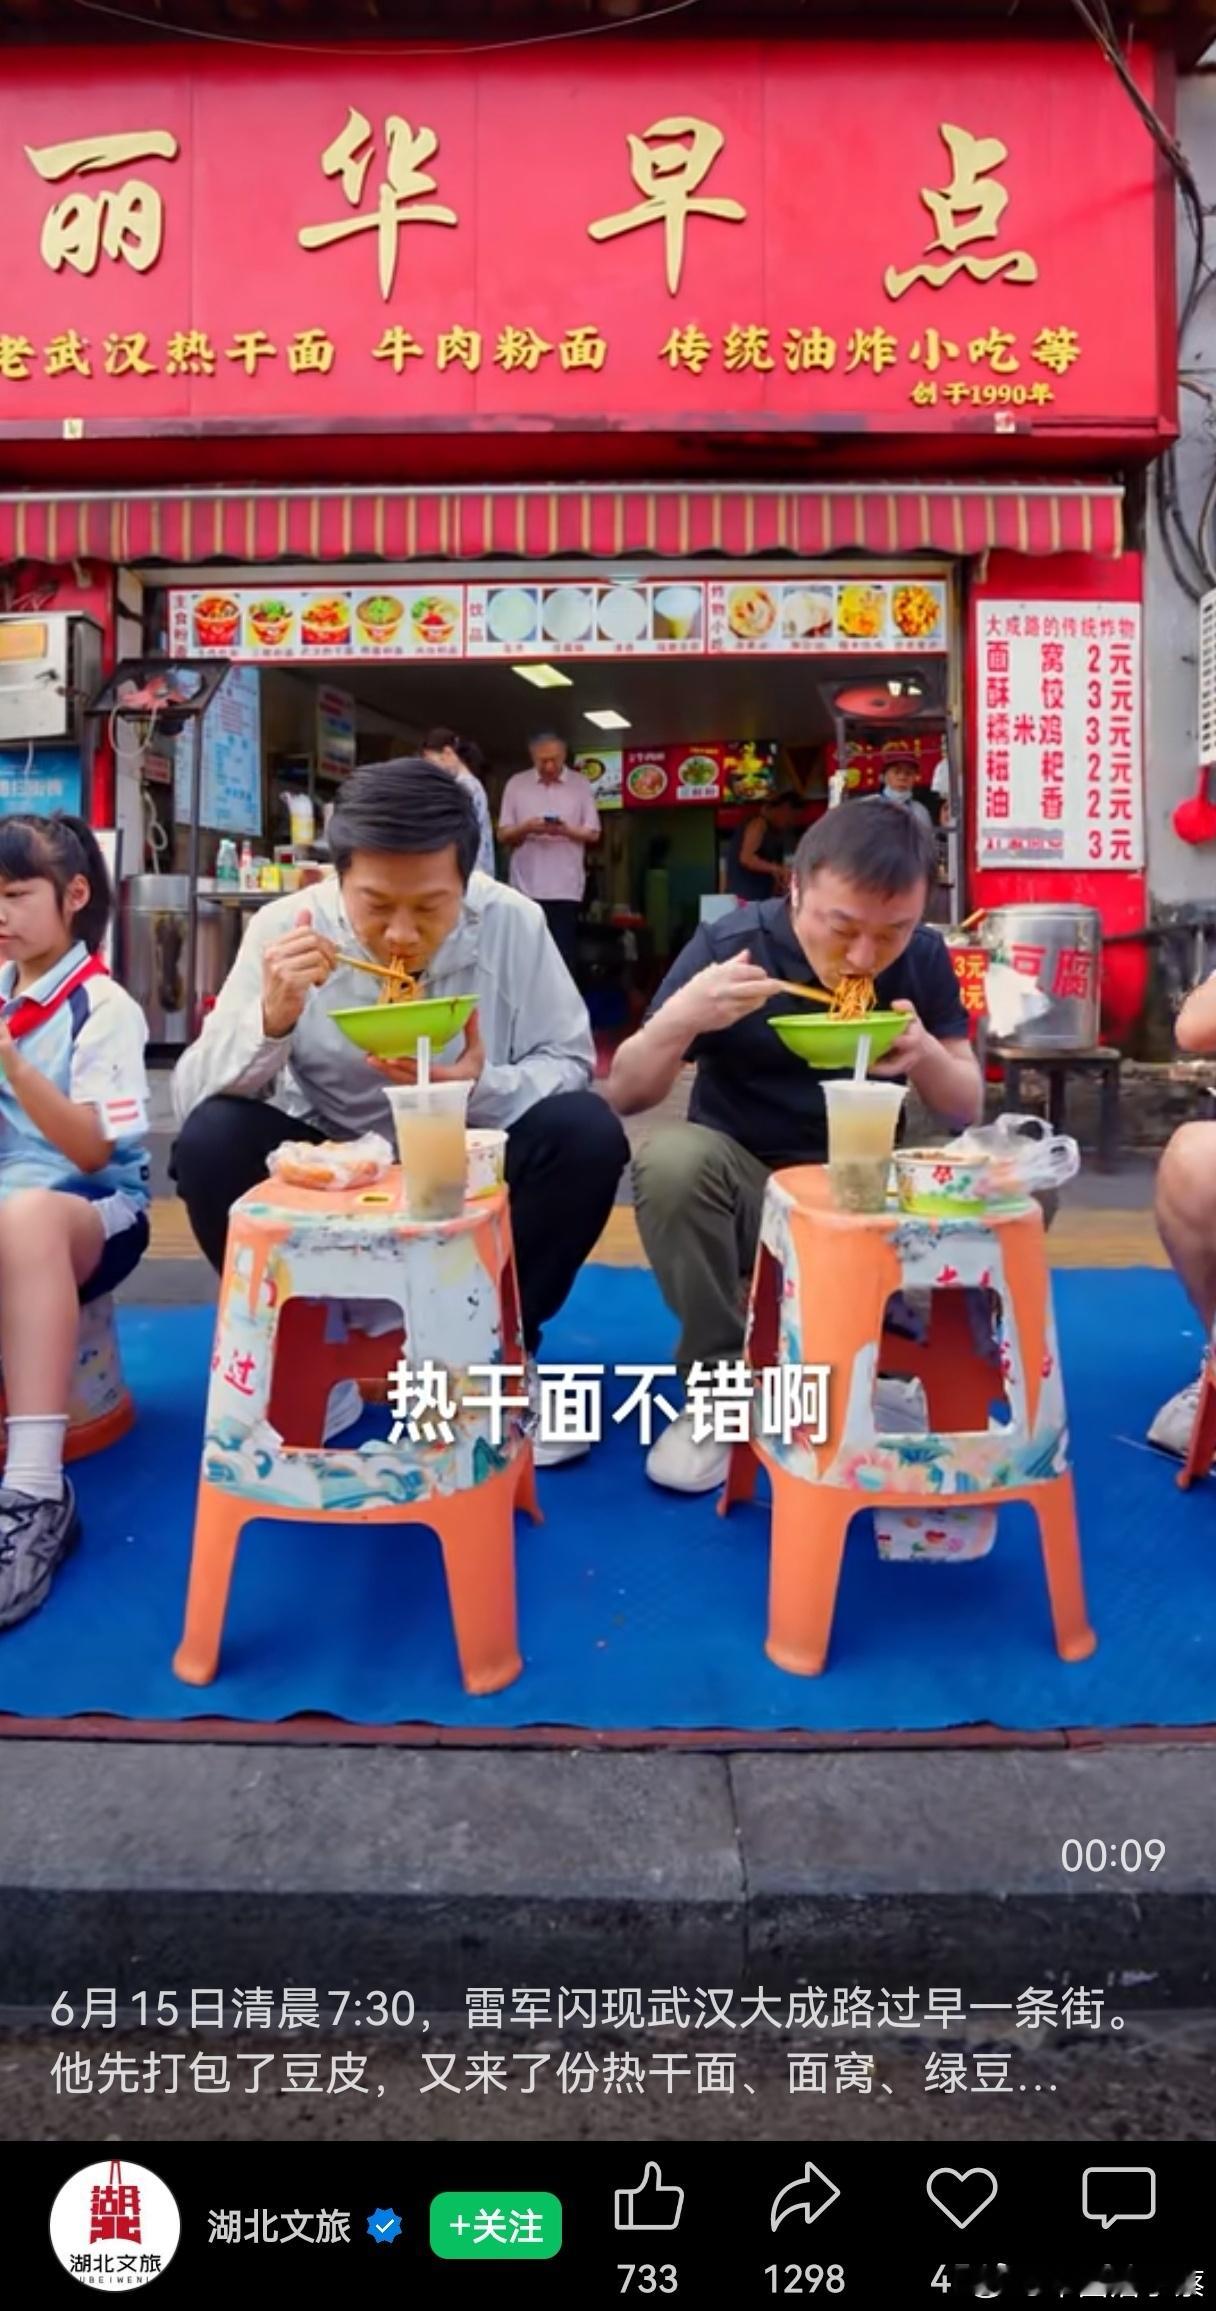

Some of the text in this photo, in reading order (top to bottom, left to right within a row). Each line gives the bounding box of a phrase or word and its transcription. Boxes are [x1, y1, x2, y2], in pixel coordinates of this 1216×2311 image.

[24, 106, 1039, 301] 丽华早点
[0, 324, 1082, 380] 老武汉热干面 牛肉粉面 传统油炸小吃等
[910, 381, 1055, 406] 创于1990年
[986, 614, 1136, 639] 大成路的传统炸物
[987, 641, 1132, 675] 面窝 2元
[987, 677, 1133, 711] 酥饺 3元
[986, 713, 1131, 747] 糯米鸡 3元
[1087, 752, 1132, 784] 2元
[986, 786, 1132, 820] 油香 2元
[1088, 828, 1132, 861] 3元
